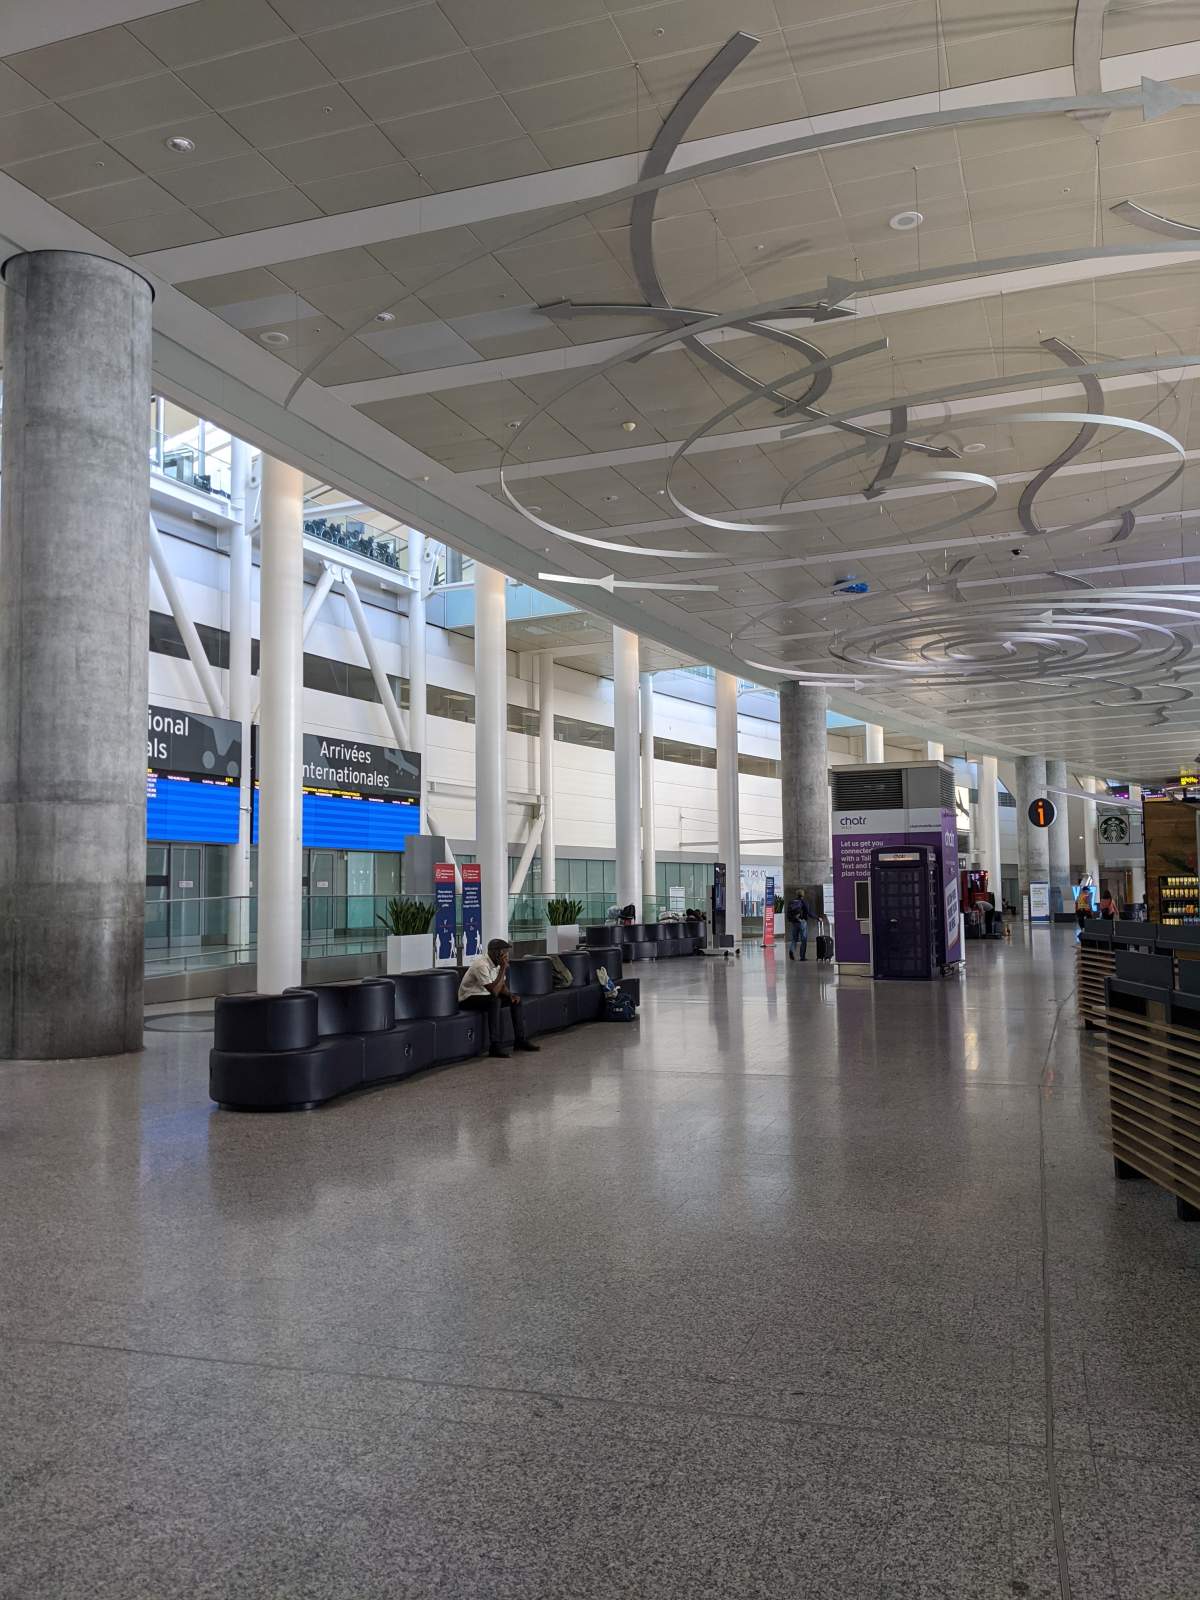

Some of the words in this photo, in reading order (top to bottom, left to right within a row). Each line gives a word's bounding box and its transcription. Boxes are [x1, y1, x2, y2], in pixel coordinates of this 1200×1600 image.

[148, 709, 189, 736] ional
[147, 738, 168, 759] als
[320, 741, 371, 764] Arrivées
[303, 762, 390, 788] nternationales
[871, 840, 884, 848] you
